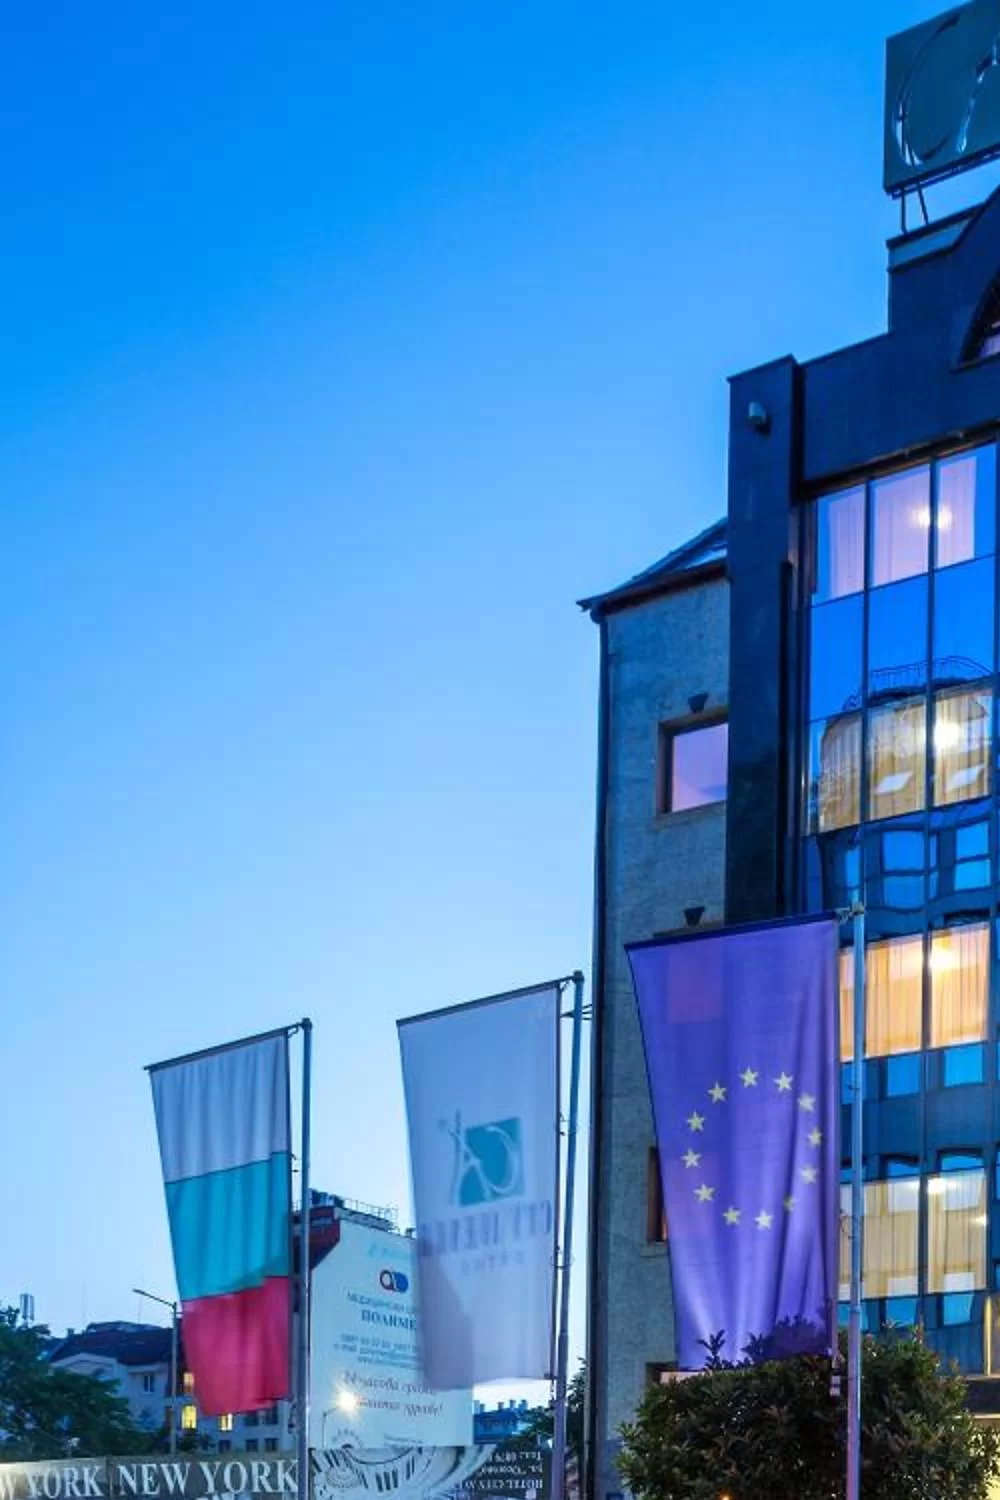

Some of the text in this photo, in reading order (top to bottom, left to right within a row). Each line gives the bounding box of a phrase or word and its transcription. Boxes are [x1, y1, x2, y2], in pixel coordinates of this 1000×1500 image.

[361, 1308, 417, 1330] ПОЛИМЕ
[24, 1465, 105, 1499] YORK
[116, 1458, 299, 1496] NEW YORK
